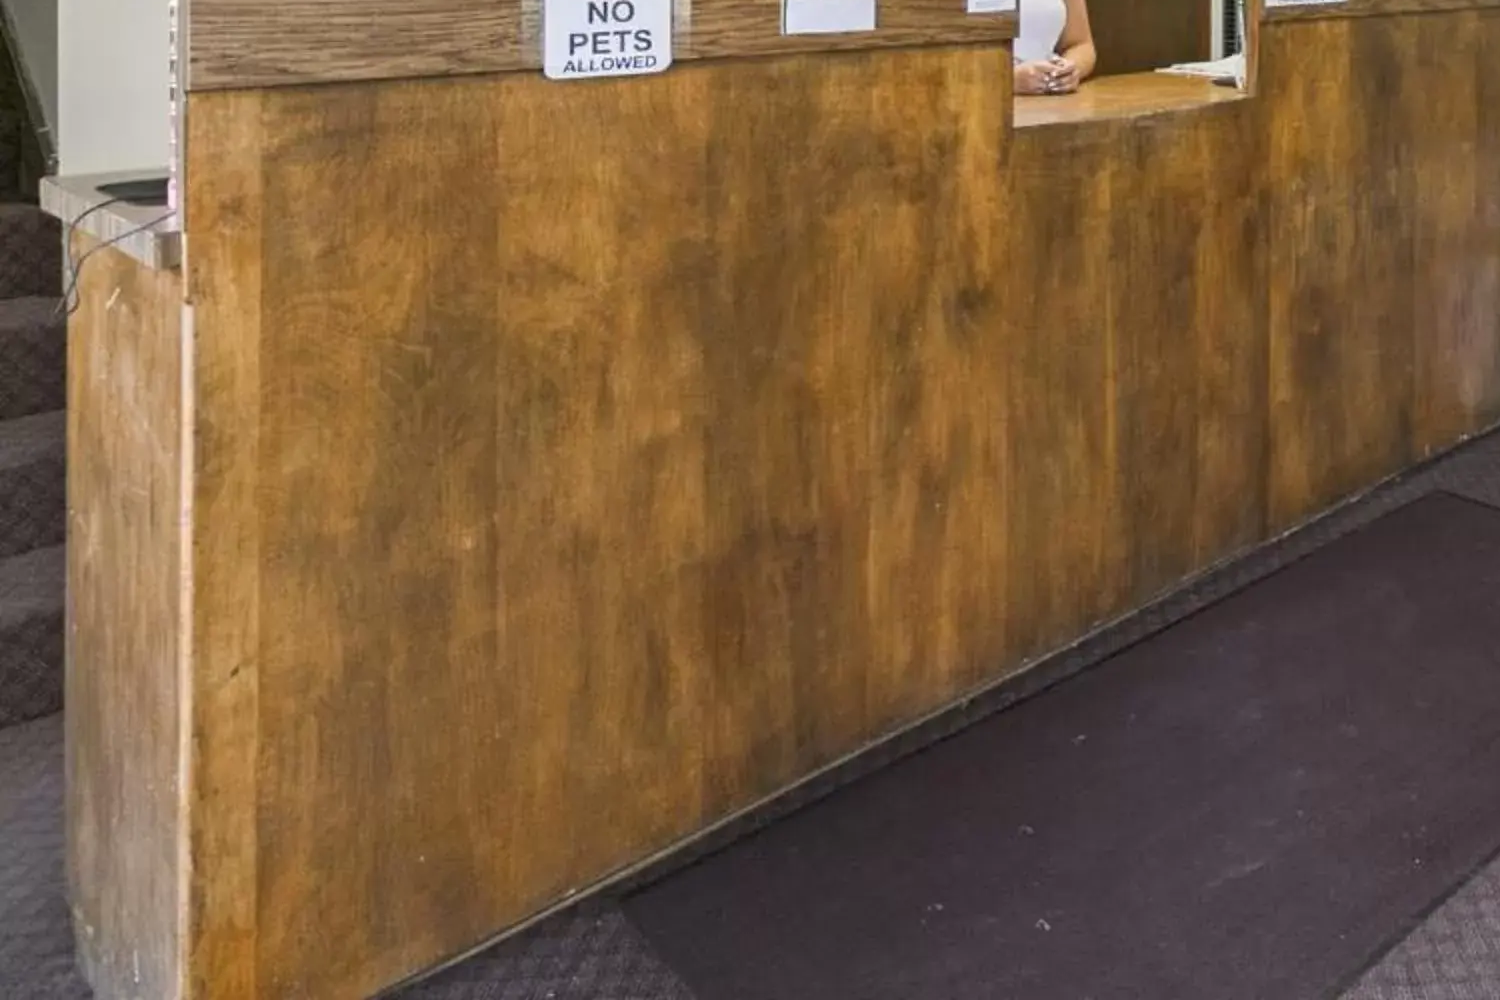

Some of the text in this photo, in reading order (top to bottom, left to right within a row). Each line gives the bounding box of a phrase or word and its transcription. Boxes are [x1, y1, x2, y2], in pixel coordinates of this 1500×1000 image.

[588, 0, 635, 24] NO
[569, 29, 653, 56] PETS
[563, 55, 657, 73] ALLOWED
